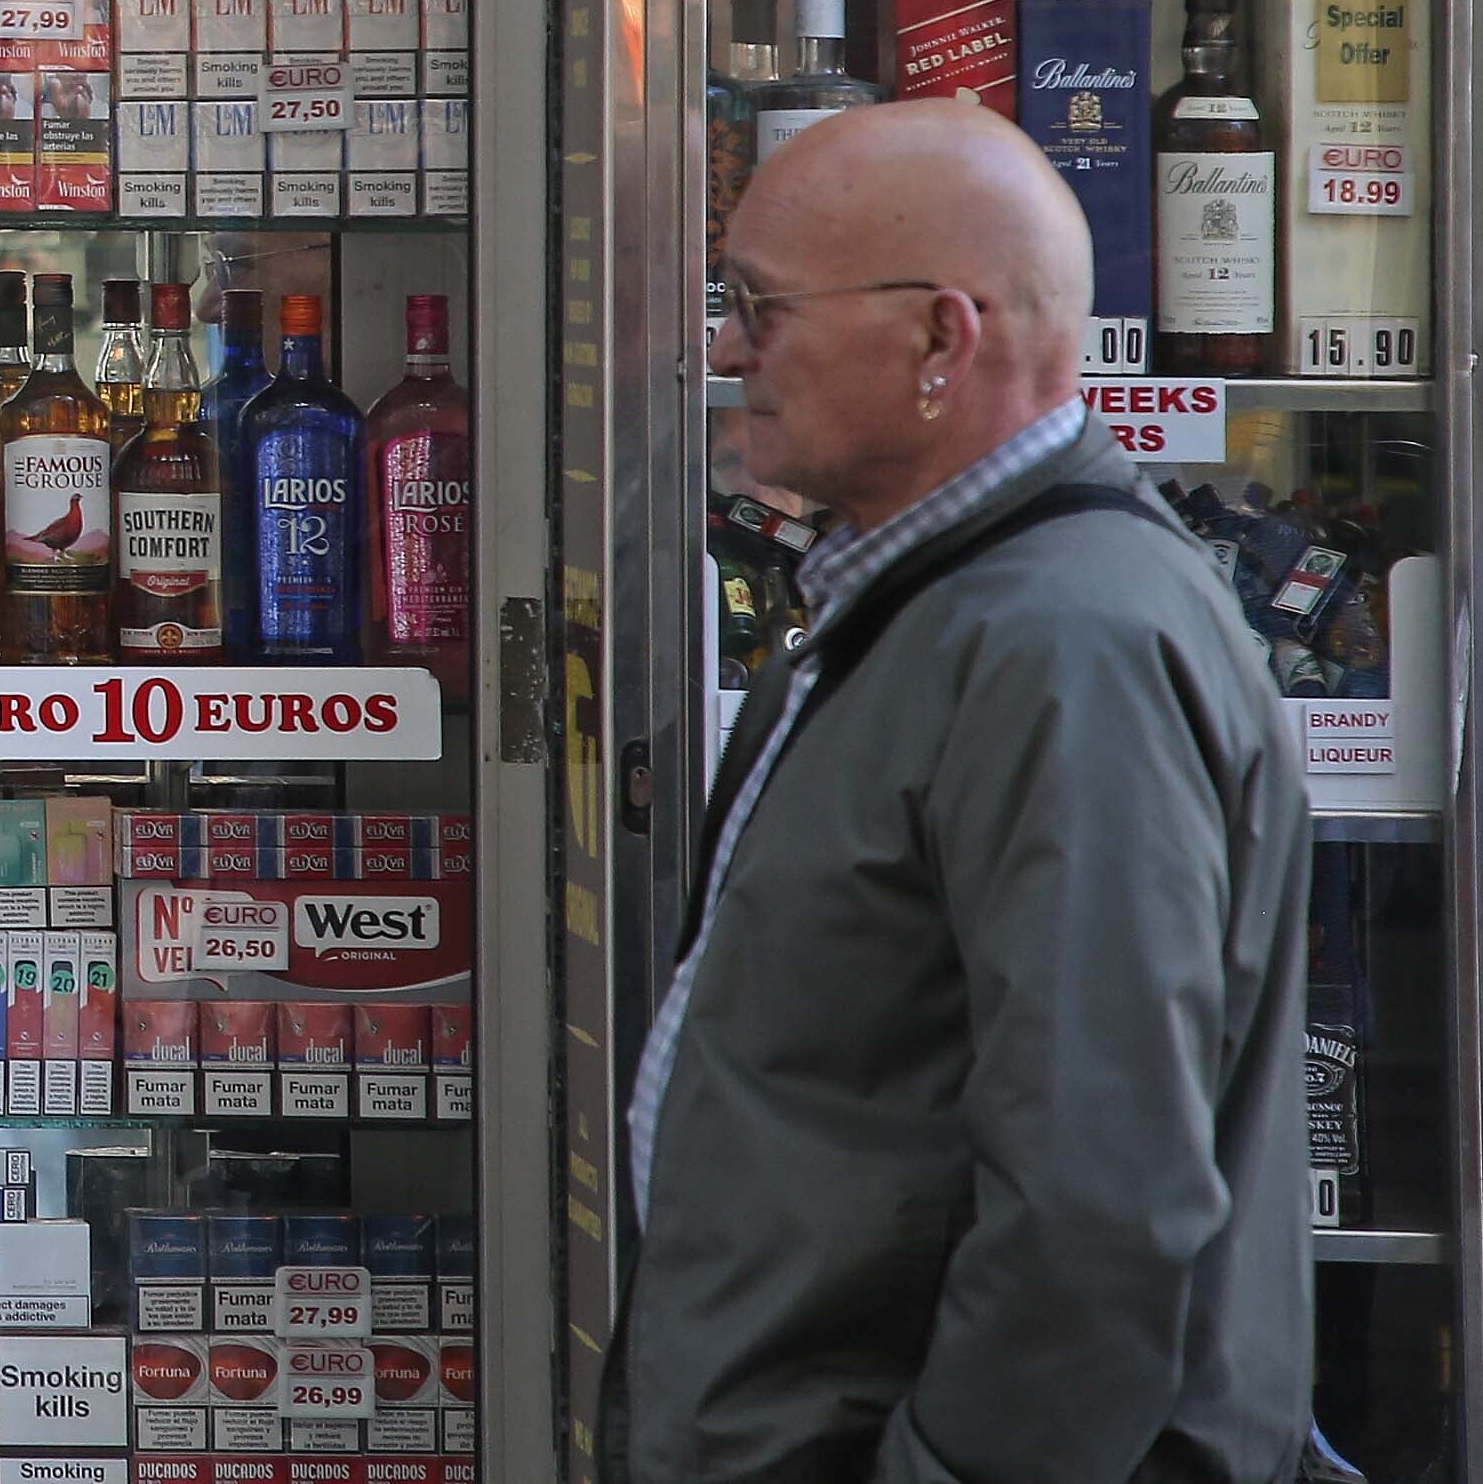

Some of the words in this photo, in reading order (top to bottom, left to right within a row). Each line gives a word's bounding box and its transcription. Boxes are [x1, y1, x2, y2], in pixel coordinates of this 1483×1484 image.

[1, 10, 69, 30] 27,99
[1327, 2, 1404, 35] Special
[906, 48, 945, 77] RED
[1340, 41, 1391, 68] Offer
[1032, 57, 1137, 90] Ballantine's
[271, 99, 341, 120] 27,50
[1323, 177, 1402, 205] 18.99
[1307, 328, 1416, 366] 15.90
[26, 455, 103, 473] FAMOUS
[24, 472, 103, 489] GROUSE
[263, 476, 347, 510] LARIOS
[124, 509, 215, 535] SOUTHERN
[129, 536, 211, 558] COMFORT
[277, 515, 330, 556] 12
[90, 677, 184, 745] 10
[193, 692, 399, 735] EUROS
[1310, 712, 1389, 729] BRANDY
[1309, 747, 1393, 765] LIQUEUR
[304, 902, 428, 941] West
[205, 939, 276, 959] 26,50
[289, 1306, 358, 1327] 27,99
[0, 1366, 123, 1394] Smoking
[138, 1366, 191, 1380] Fortuna
[35, 1394, 90, 1418] kills
